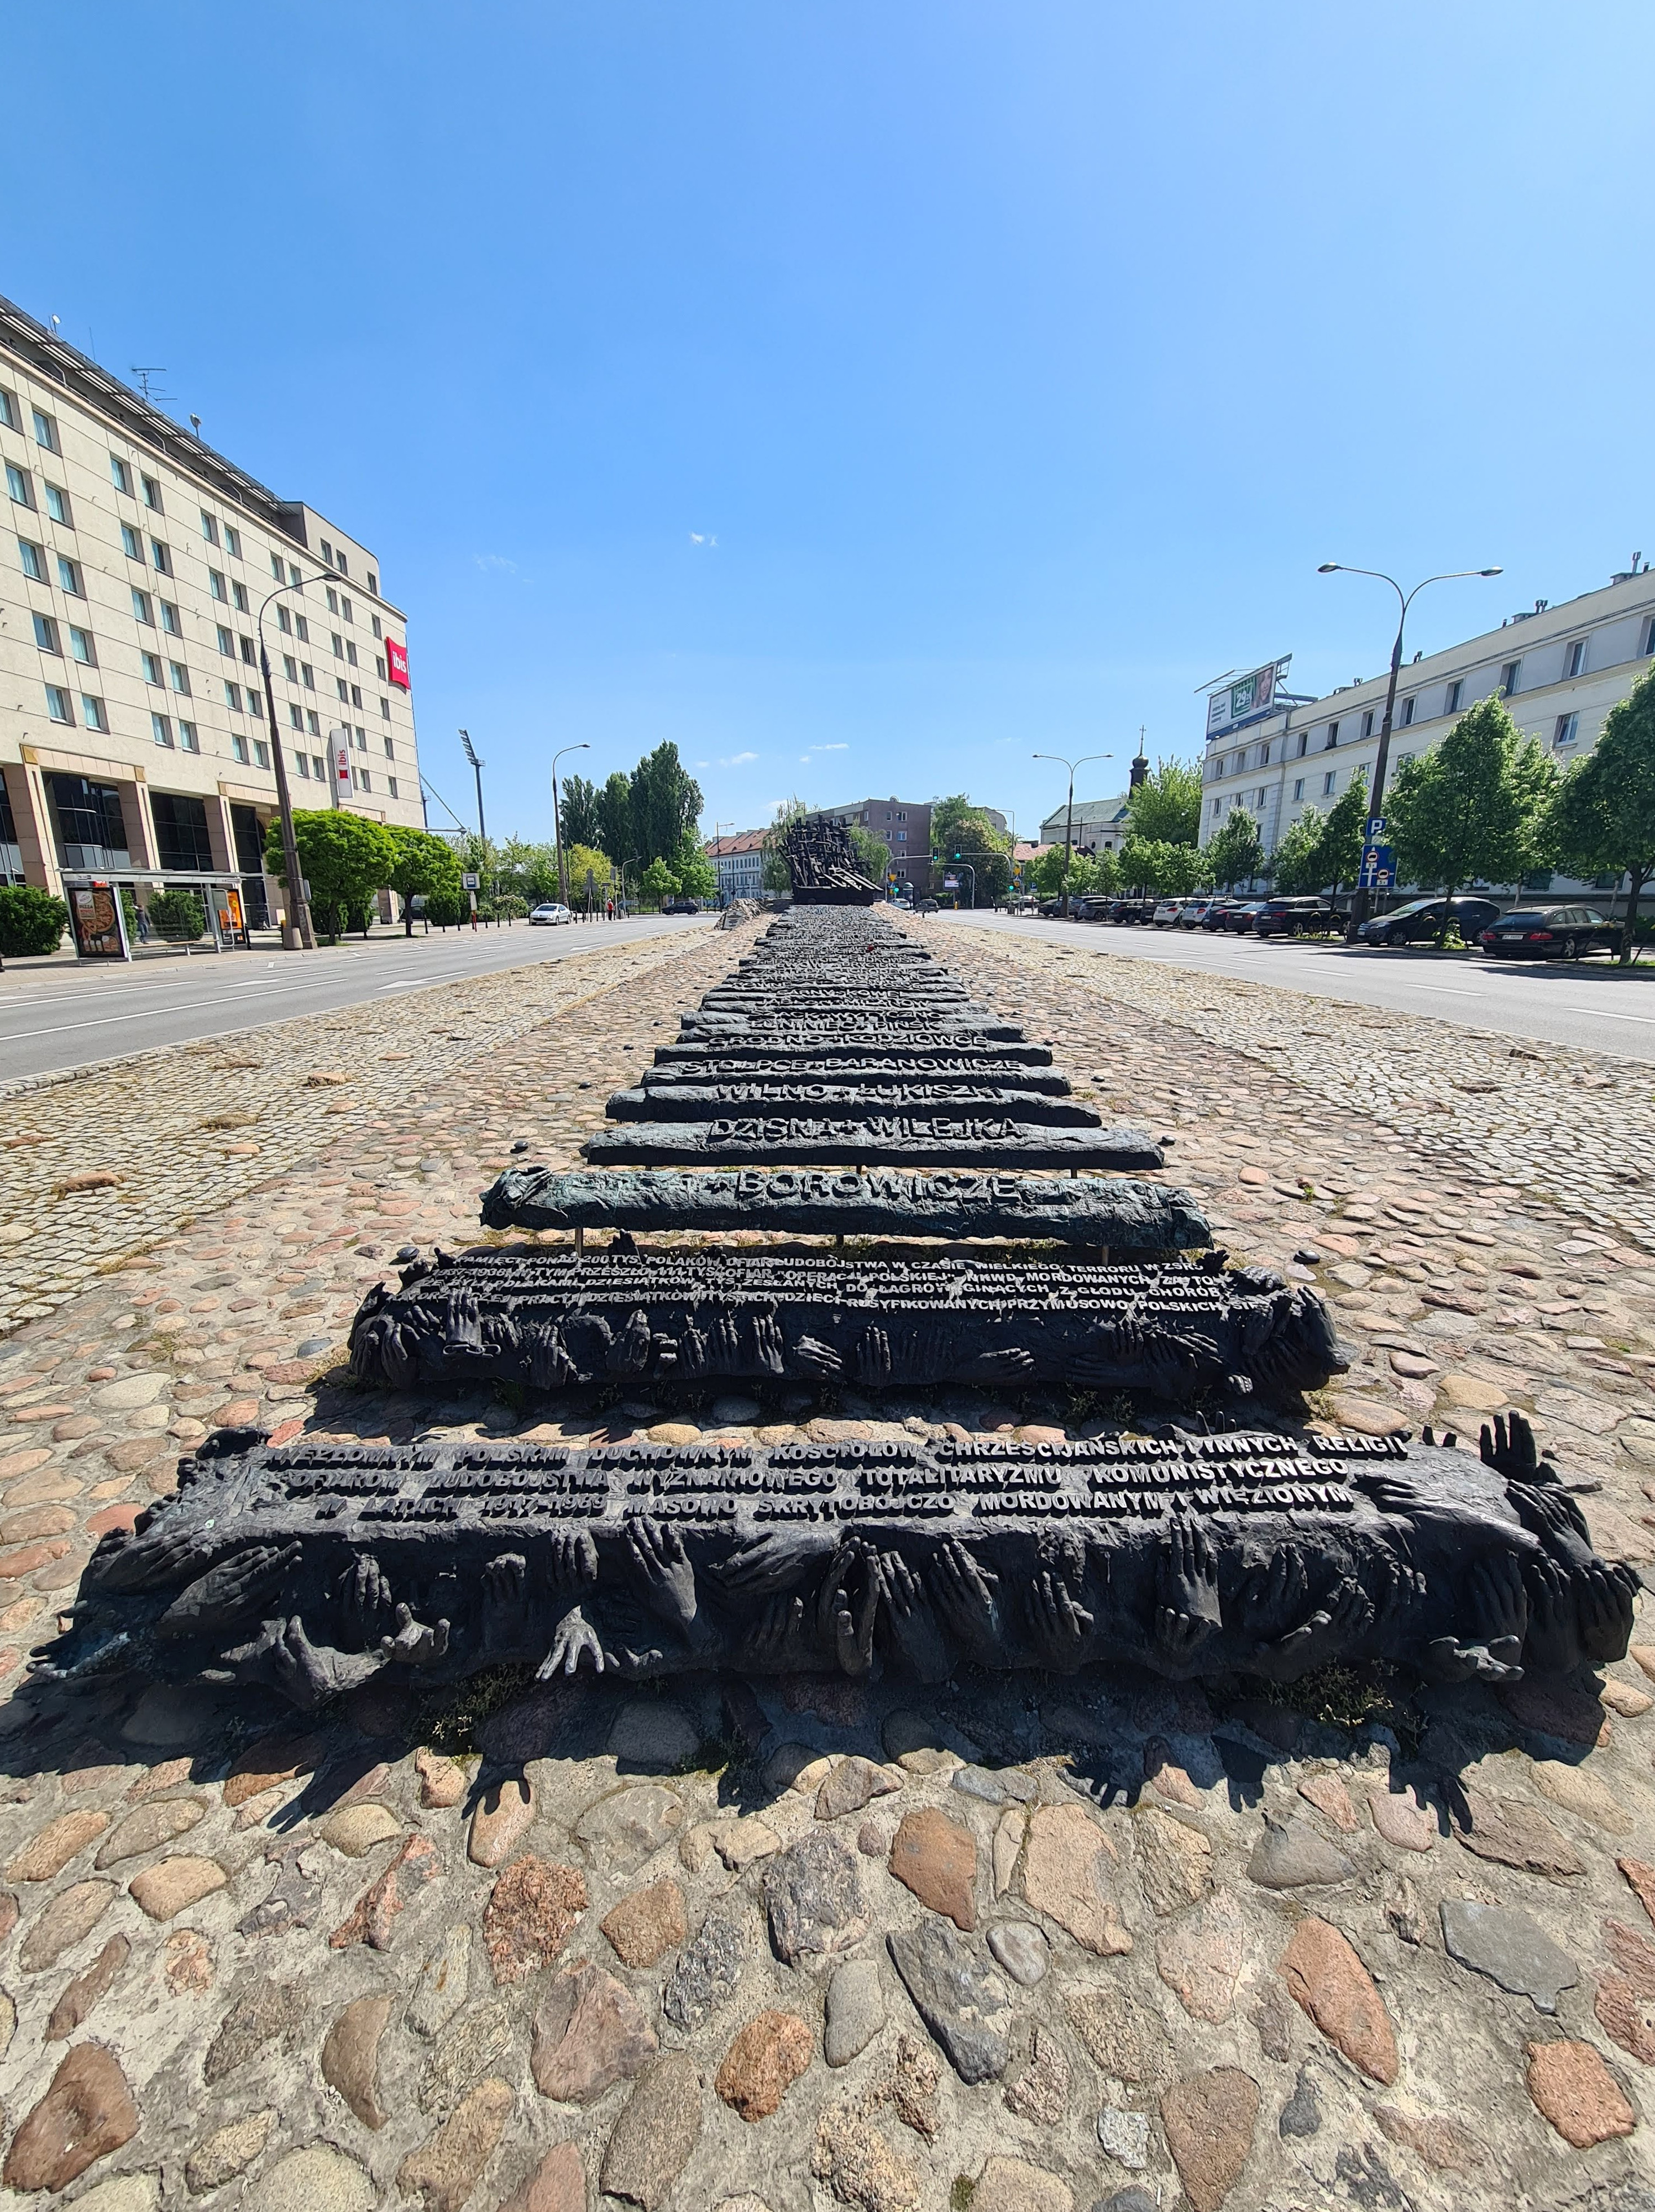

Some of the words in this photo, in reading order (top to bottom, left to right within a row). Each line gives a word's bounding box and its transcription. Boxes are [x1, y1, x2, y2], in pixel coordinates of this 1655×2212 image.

[392, 651, 407, 673] ibis
[338, 749, 347, 765] ibis
[1371, 820, 1382, 834] P
[846, 989, 905, 998] KOWEL
[751, 1009, 815, 1019] SZACK
[709, 1034, 823, 1046] GRODNO
[842, 1033, 988, 1046] KODZIOWCE
[825, 1057, 1024, 1071] BARANOWICZE
[718, 1082, 829, 1097] WILNO
[711, 1117, 839, 1139] DZISNA
[866, 1117, 1024, 1139] WILEJKA
[739, 1168, 1020, 1205] BOROWICZE
[583, 1255, 609, 1265] 200
[911, 1261, 966, 1270] CZASIE
[974, 1262, 1060, 1270] WIELKIEGO
[1066, 1264, 1140, 1273] TERRORU
[535, 1267, 567, 1277] TYM
[569, 1267, 649, 1276] PRZESZŁO
[657, 1266, 683, 1276] 111
[725, 1268, 773, 1278] OFIAR
[1026, 1272, 1151, 1285] MORDOWANYCH
[741, 1278, 838, 1290] ZESŁANYCH
[846, 1283, 868, 1292] DO
[963, 1283, 1049, 1294] GINĄCYCH
[1059, 1286, 1075, 1295] Z
[784, 1292, 842, 1304] DZIECI
[848, 1297, 1001, 1311] RUSYFIKOWANYCH
[1138, 1300, 1223, 1312] POLSKICH
[455, 1446, 569, 1463] POLSKIM
[590, 1445, 754, 1461] DUCHOWNYM
[1185, 1439, 1198, 1455] I
[1203, 1437, 1299, 1455] INNYCH
[1316, 1435, 1408, 1454] RELIGII
[632, 1467, 838, 1489] WYZNANIOWEGO
[863, 1466, 1062, 1486] TOTALITARYZMU
[1093, 1459, 1349, 1484] KOMUNISTYCZNEGO
[362, 1497, 463, 1516] LATACH
[484, 1495, 607, 1512] 1917-1989
[627, 1496, 738, 1515] MASOWO
[978, 1491, 1162, 1512] MORDOWANYM
[1175, 1491, 1189, 1507] I
